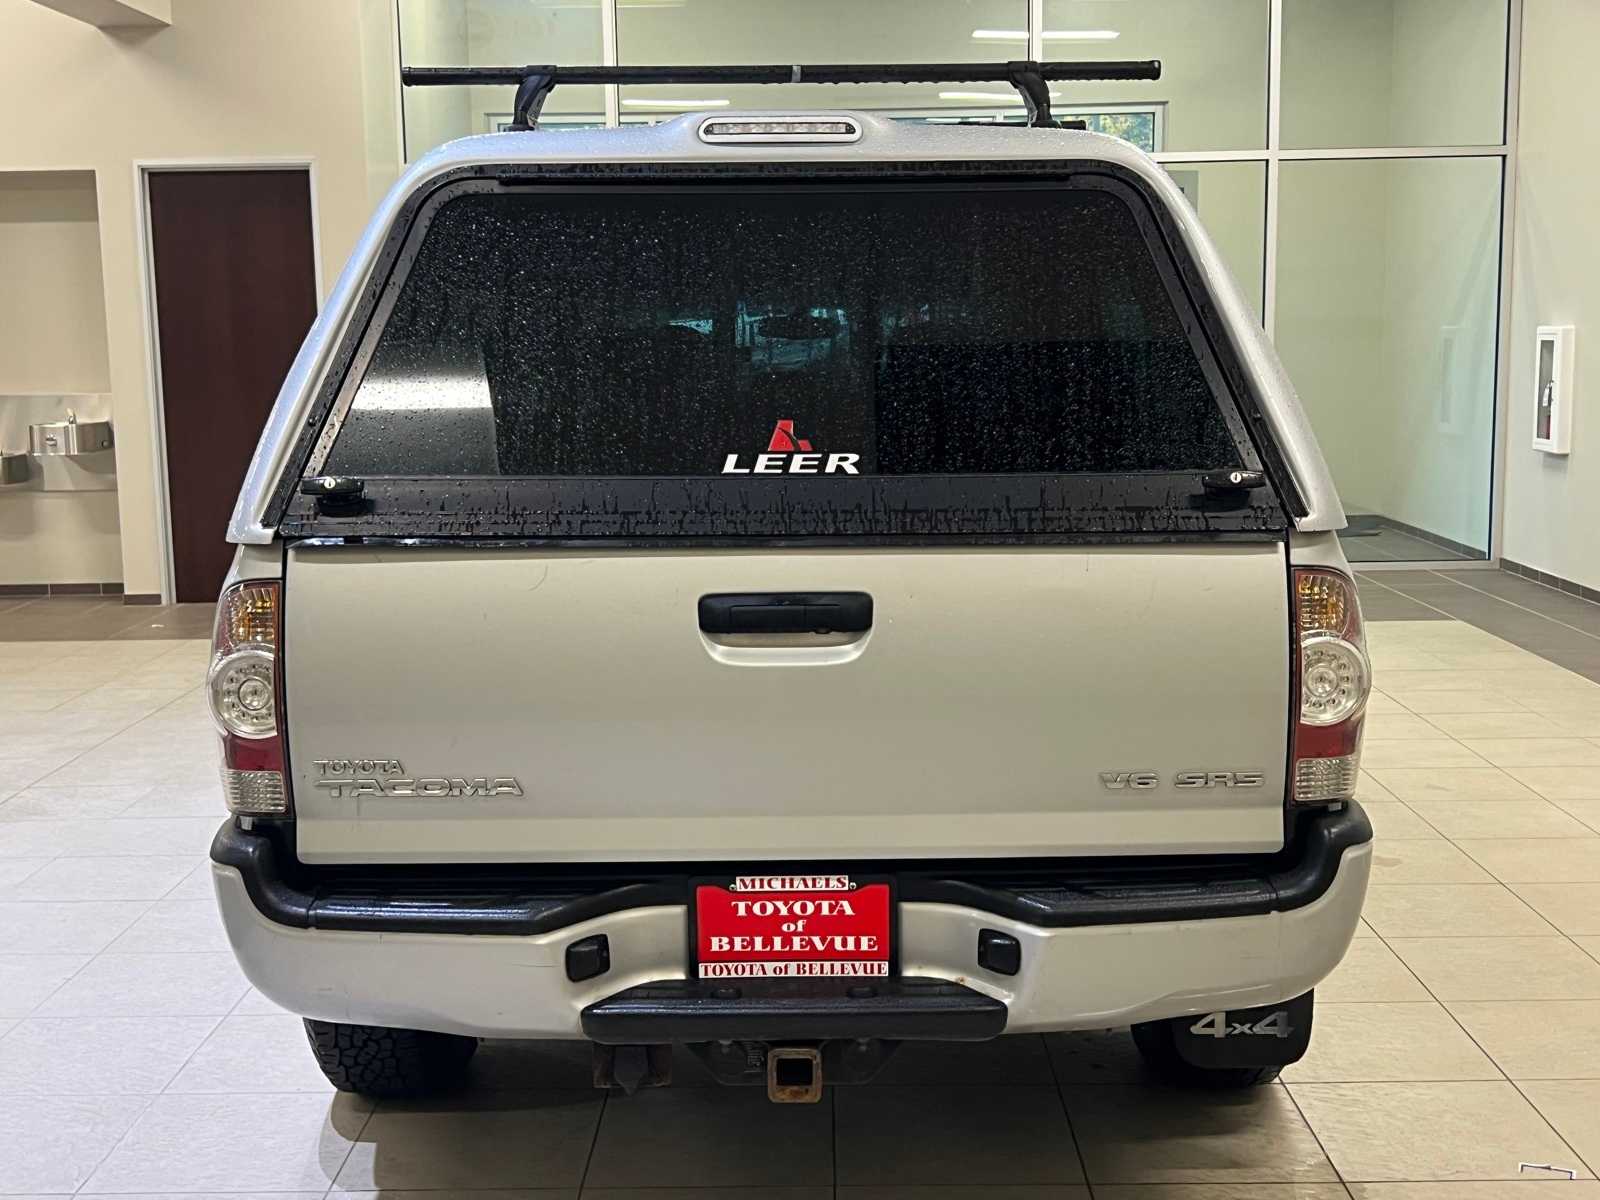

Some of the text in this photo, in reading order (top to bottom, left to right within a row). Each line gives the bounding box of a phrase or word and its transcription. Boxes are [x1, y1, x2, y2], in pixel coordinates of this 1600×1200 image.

[721, 453, 860, 475] LEER
[313, 759, 405, 776] TOYOTA
[314, 777, 523, 797] TACOMA
[1100, 772, 1264, 789] V6 SR5
[738, 876, 847, 890] MICHAELS
[732, 900, 855, 917] TOYOTA
[781, 919, 807, 933] of
[710, 935, 878, 952] BELLEVUE
[701, 962, 887, 977] TOYOTA of BELLEVUE
[1190, 1011, 1294, 1038] 4x4
